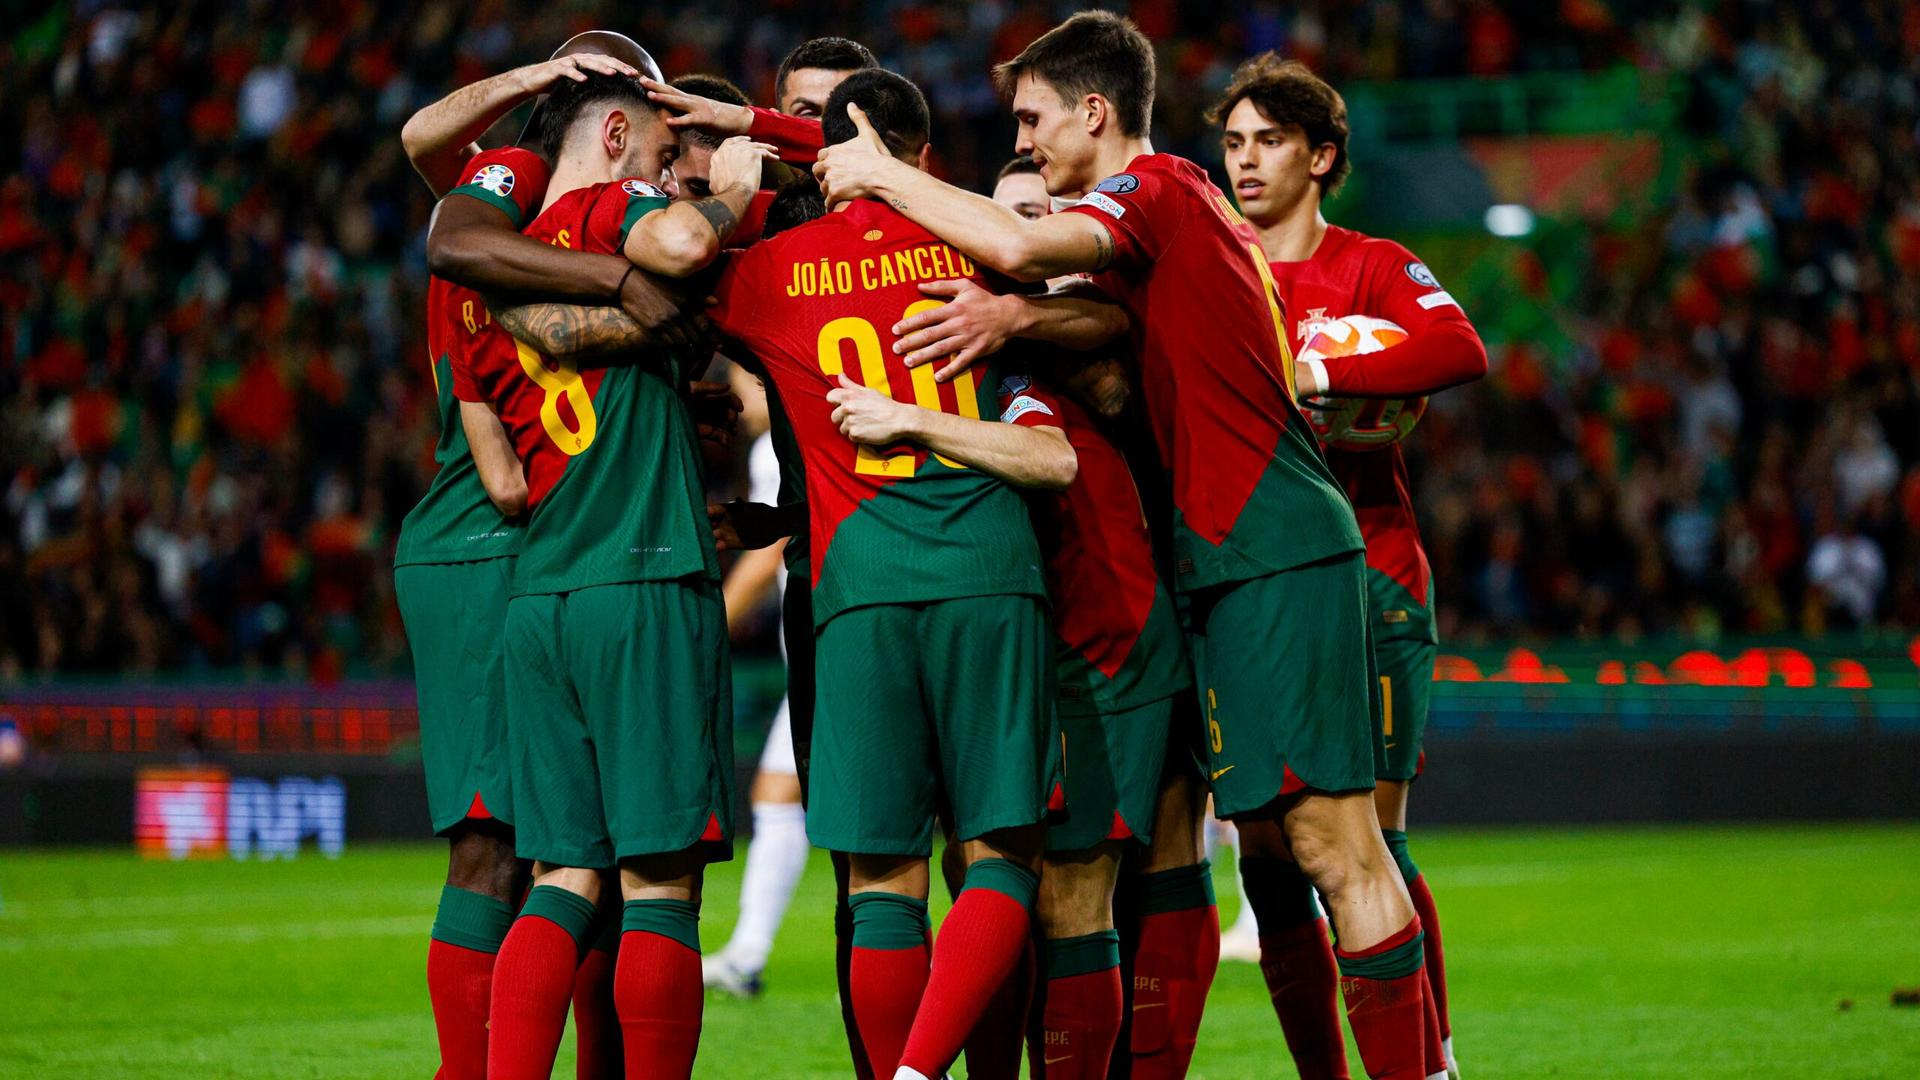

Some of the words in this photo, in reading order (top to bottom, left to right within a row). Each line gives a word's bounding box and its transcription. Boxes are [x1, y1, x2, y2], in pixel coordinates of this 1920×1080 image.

[786, 257, 853, 297] JOÃO
[512, 335, 597, 456] 8
[1207, 687, 1222, 753] 6
